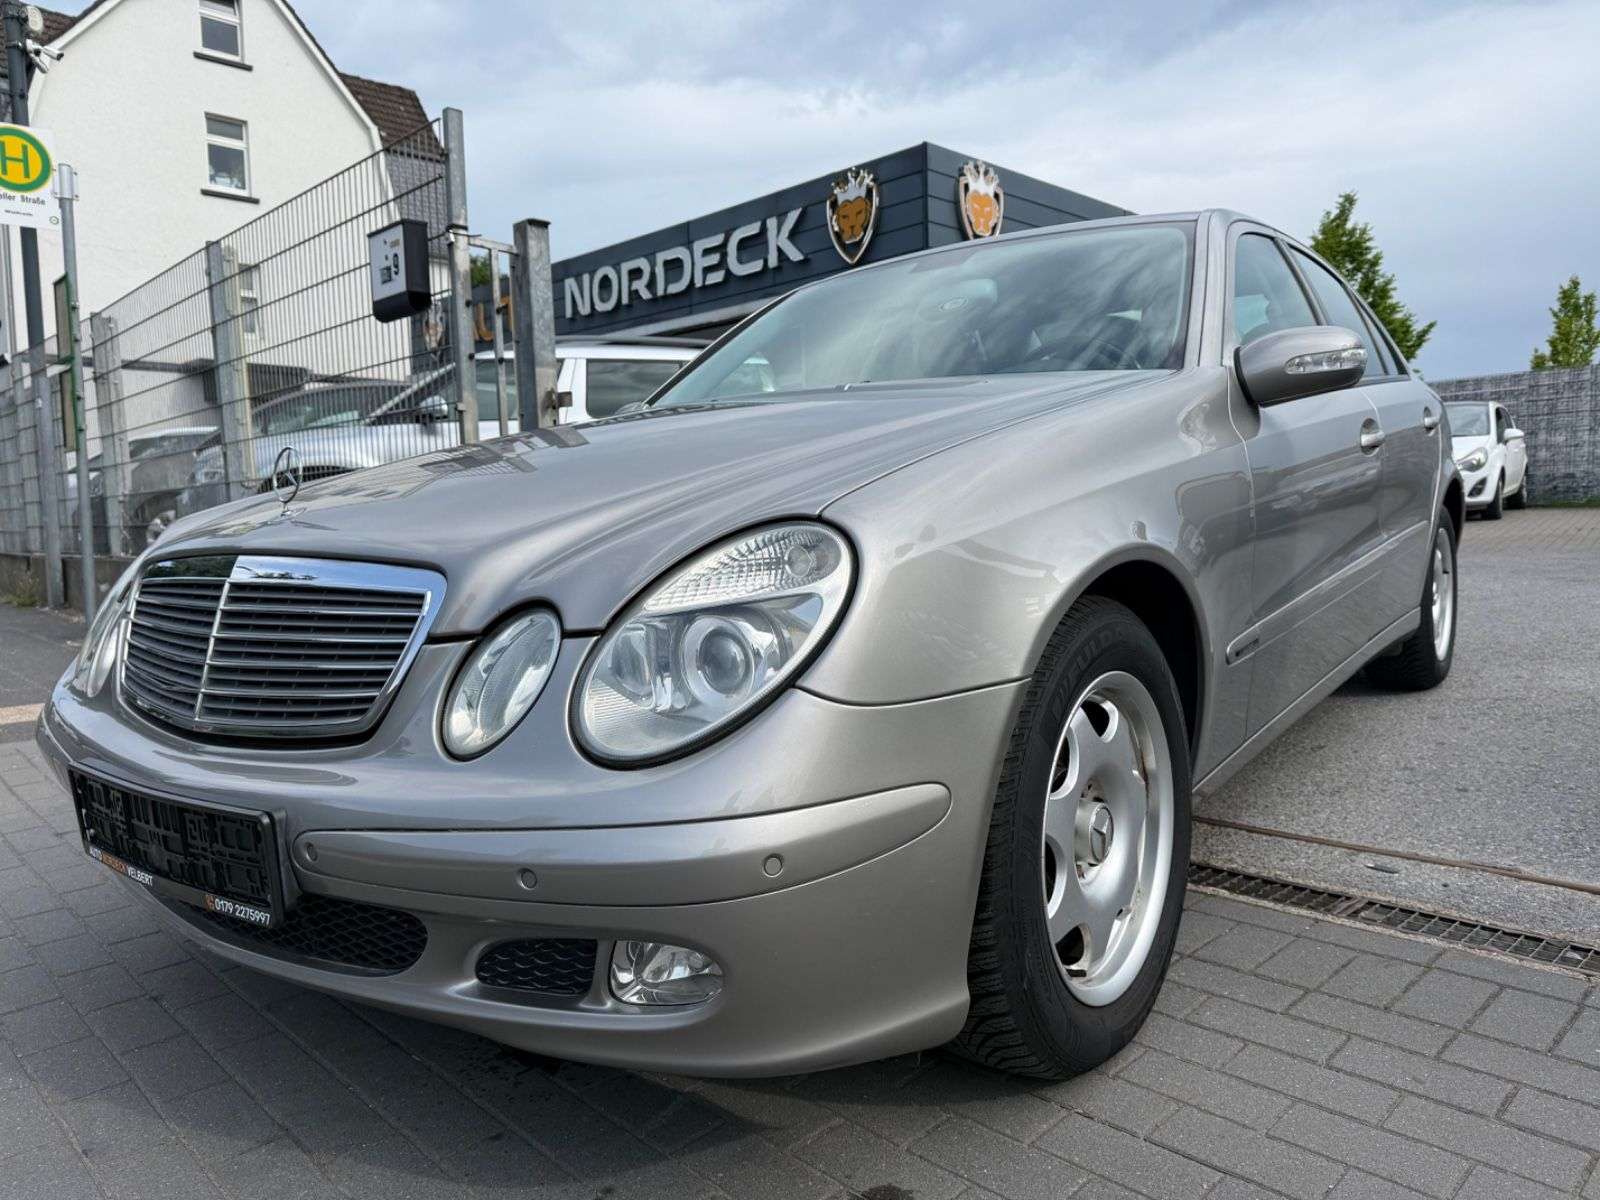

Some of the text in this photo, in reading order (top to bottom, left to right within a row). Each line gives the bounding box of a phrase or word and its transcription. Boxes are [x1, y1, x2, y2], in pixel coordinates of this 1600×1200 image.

[0, 141, 30, 179] H
[20, 194, 46, 206] Straße
[563, 207, 806, 319] NORDECK
[214, 898, 271, 926] 0179 2275997
